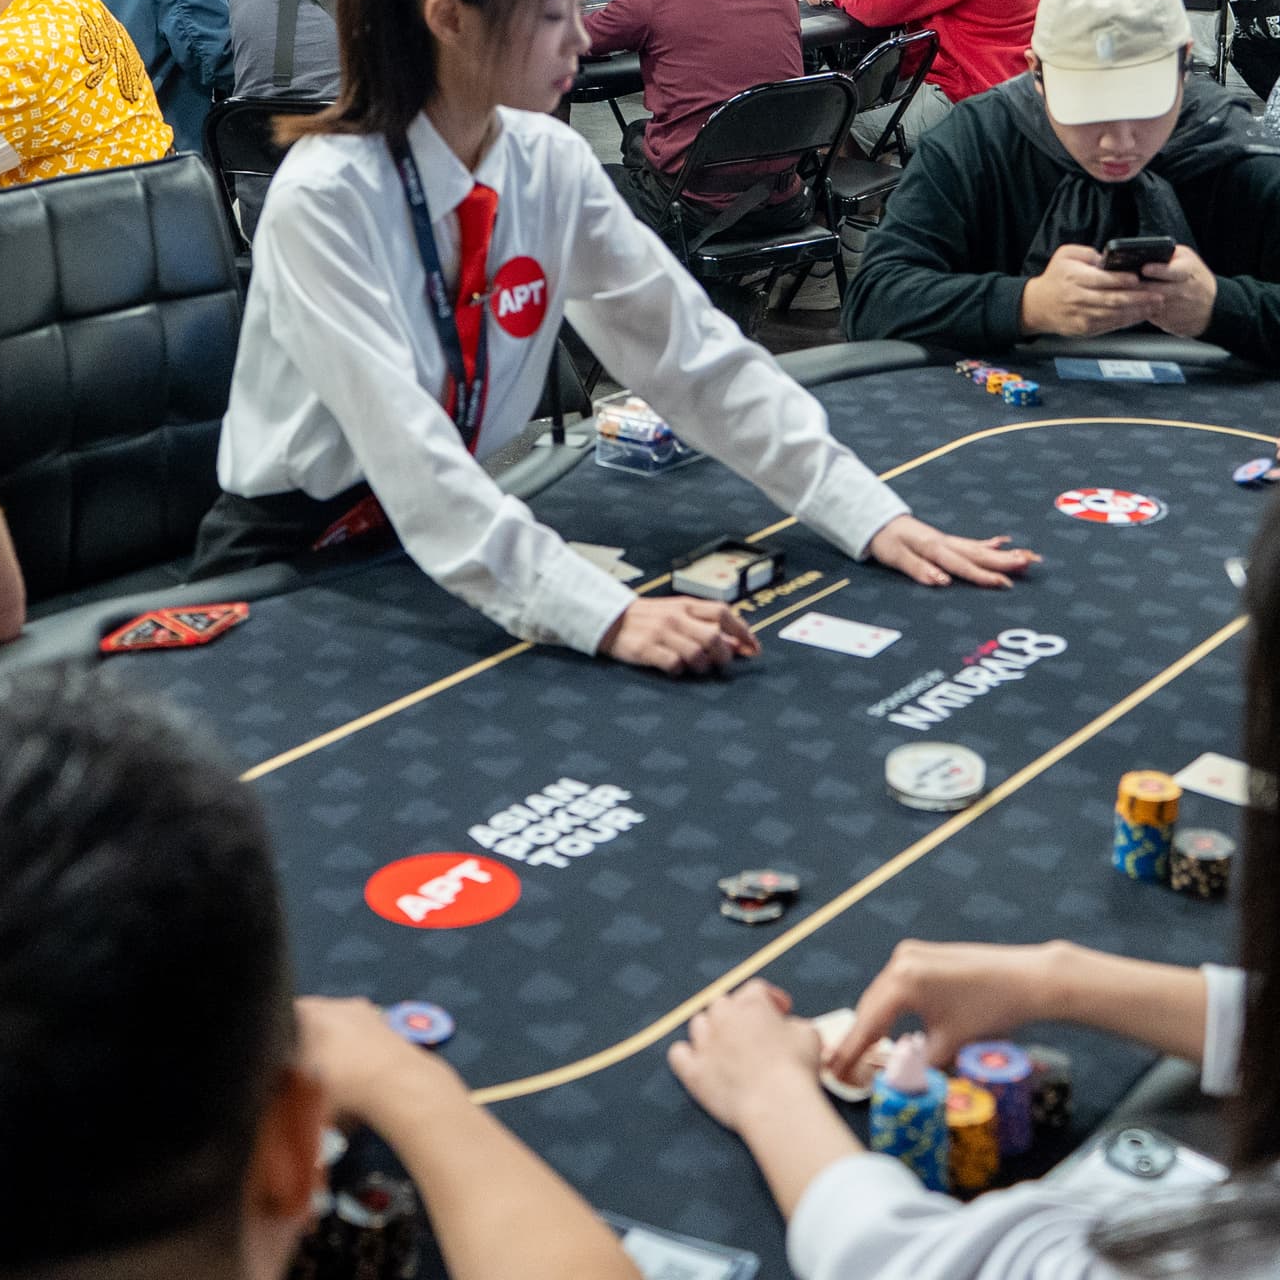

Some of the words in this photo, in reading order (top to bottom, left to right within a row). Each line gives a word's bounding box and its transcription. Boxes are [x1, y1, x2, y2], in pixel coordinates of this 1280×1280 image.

[497, 278, 547, 318] APT
[888, 627, 1068, 731] NATURAL8
[467, 776, 591, 849] ASIAN
[492, 783, 633, 861] POKER
[525, 806, 647, 869] TOUR
[396, 858, 492, 923] APT
